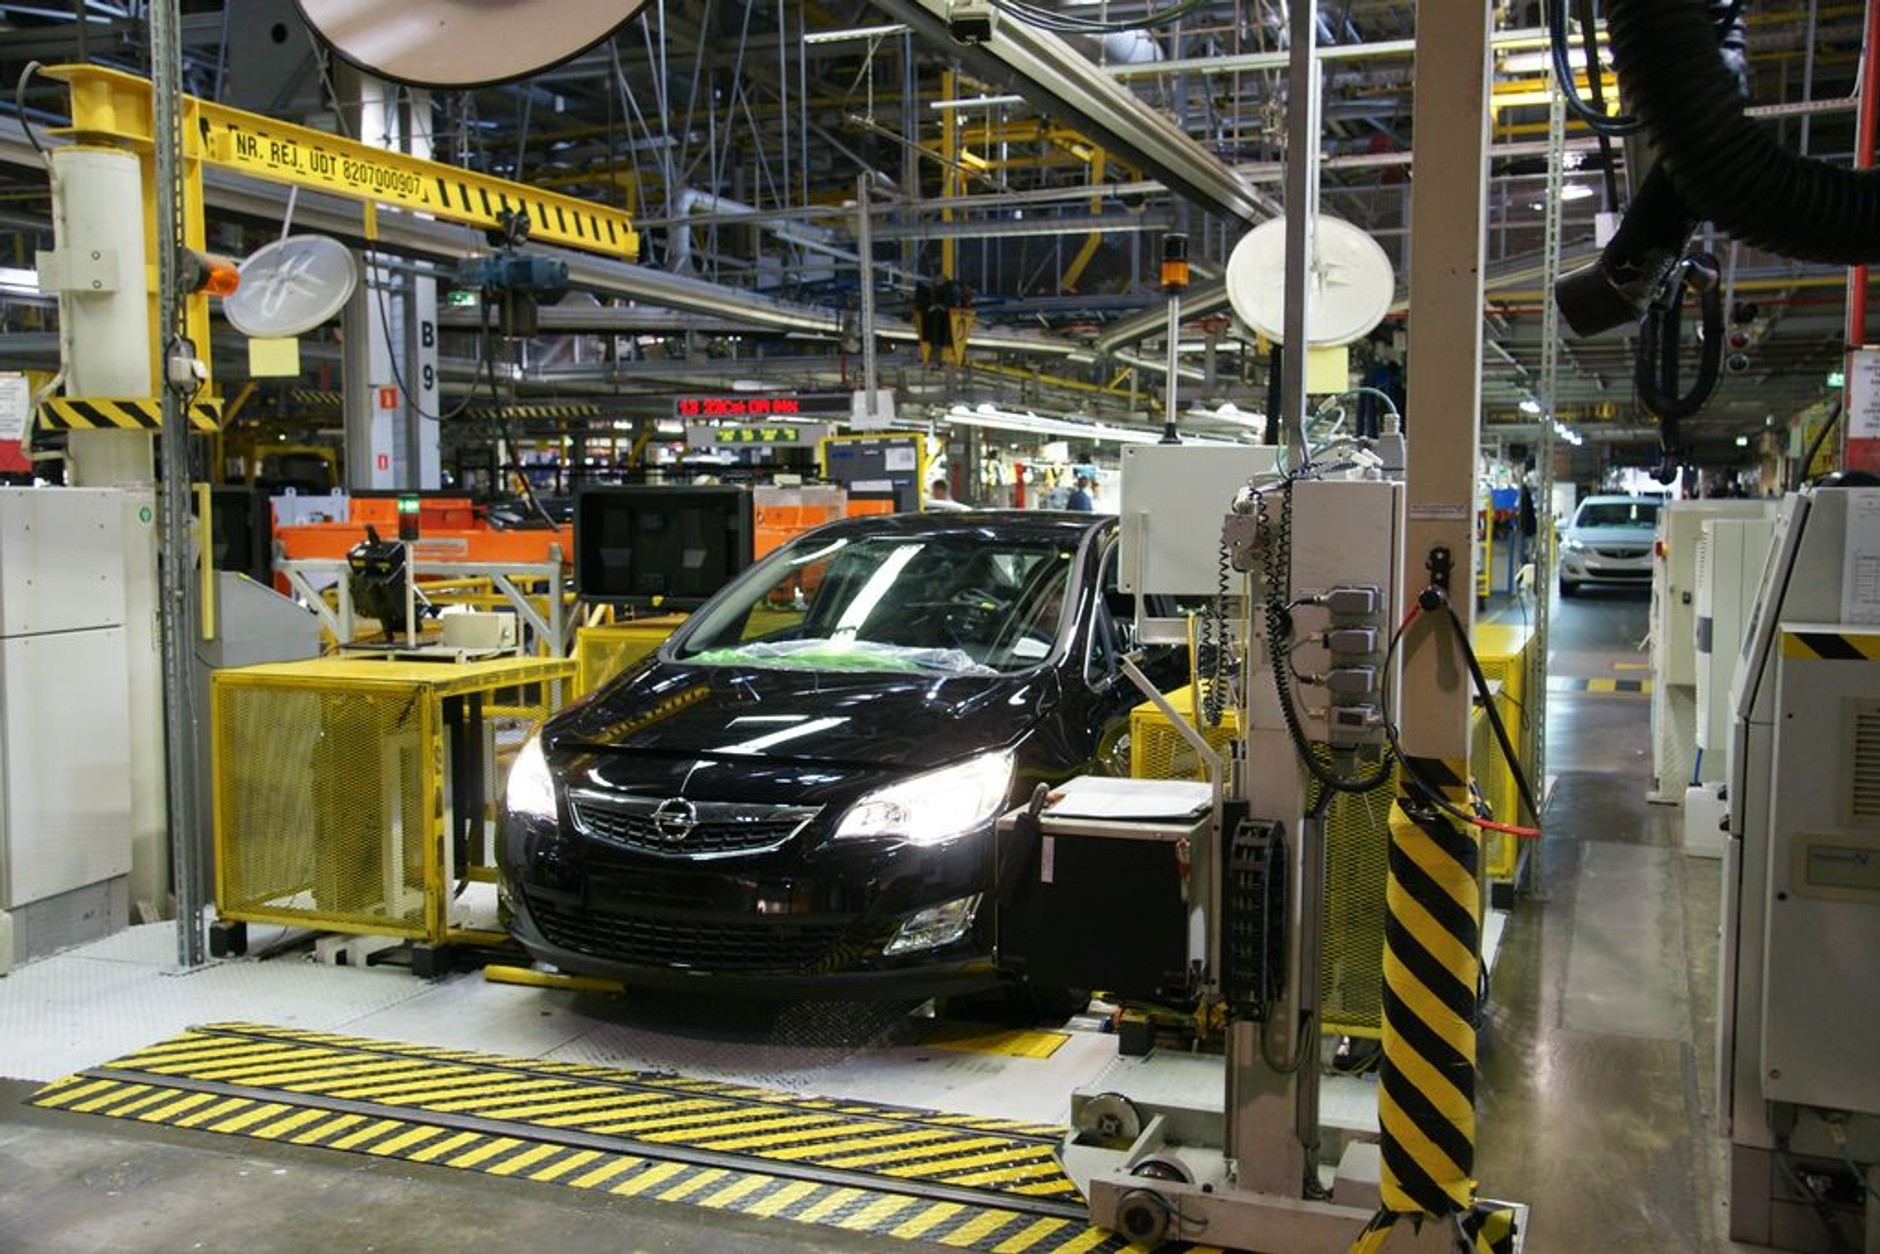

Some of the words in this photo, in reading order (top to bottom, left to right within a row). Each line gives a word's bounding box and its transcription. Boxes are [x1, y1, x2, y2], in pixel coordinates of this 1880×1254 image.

[236, 132, 264, 159] NR.
[270, 142, 303, 168] REJ.
[310, 148, 337, 176] UDT
[342, 159, 421, 196] 8207000907
[421, 321, 434, 348] B
[423, 364, 434, 391] 9
